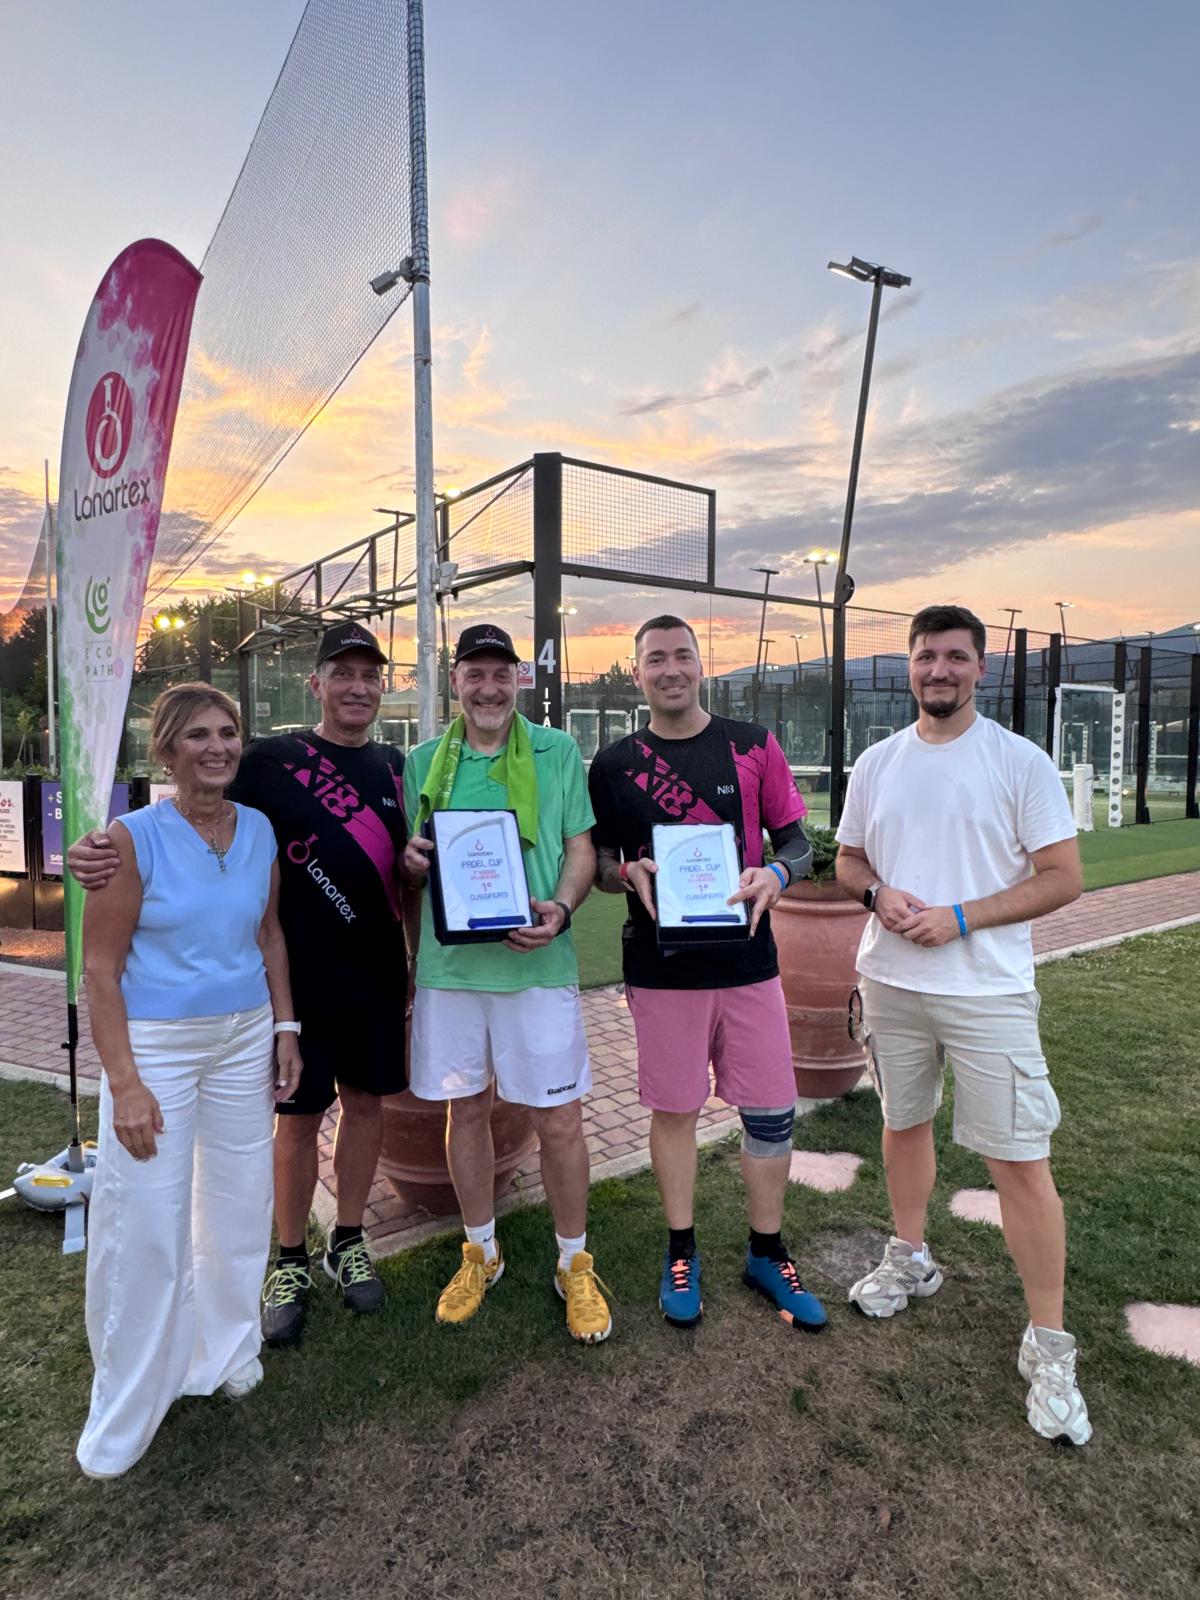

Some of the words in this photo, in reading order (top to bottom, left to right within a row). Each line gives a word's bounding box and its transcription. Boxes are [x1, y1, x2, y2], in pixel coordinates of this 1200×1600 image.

[74, 477, 151, 522] Lanartex
[85, 646, 112, 660] ECO
[538, 639, 557, 673] 4
[85, 664, 114, 676] PATH
[461, 860, 487, 868] PADEL
[488, 858, 503, 867] CUP
[679, 864, 705, 872] PADEL
[706, 863, 721, 871] CUP
[306, 858, 357, 923] Lanartex
